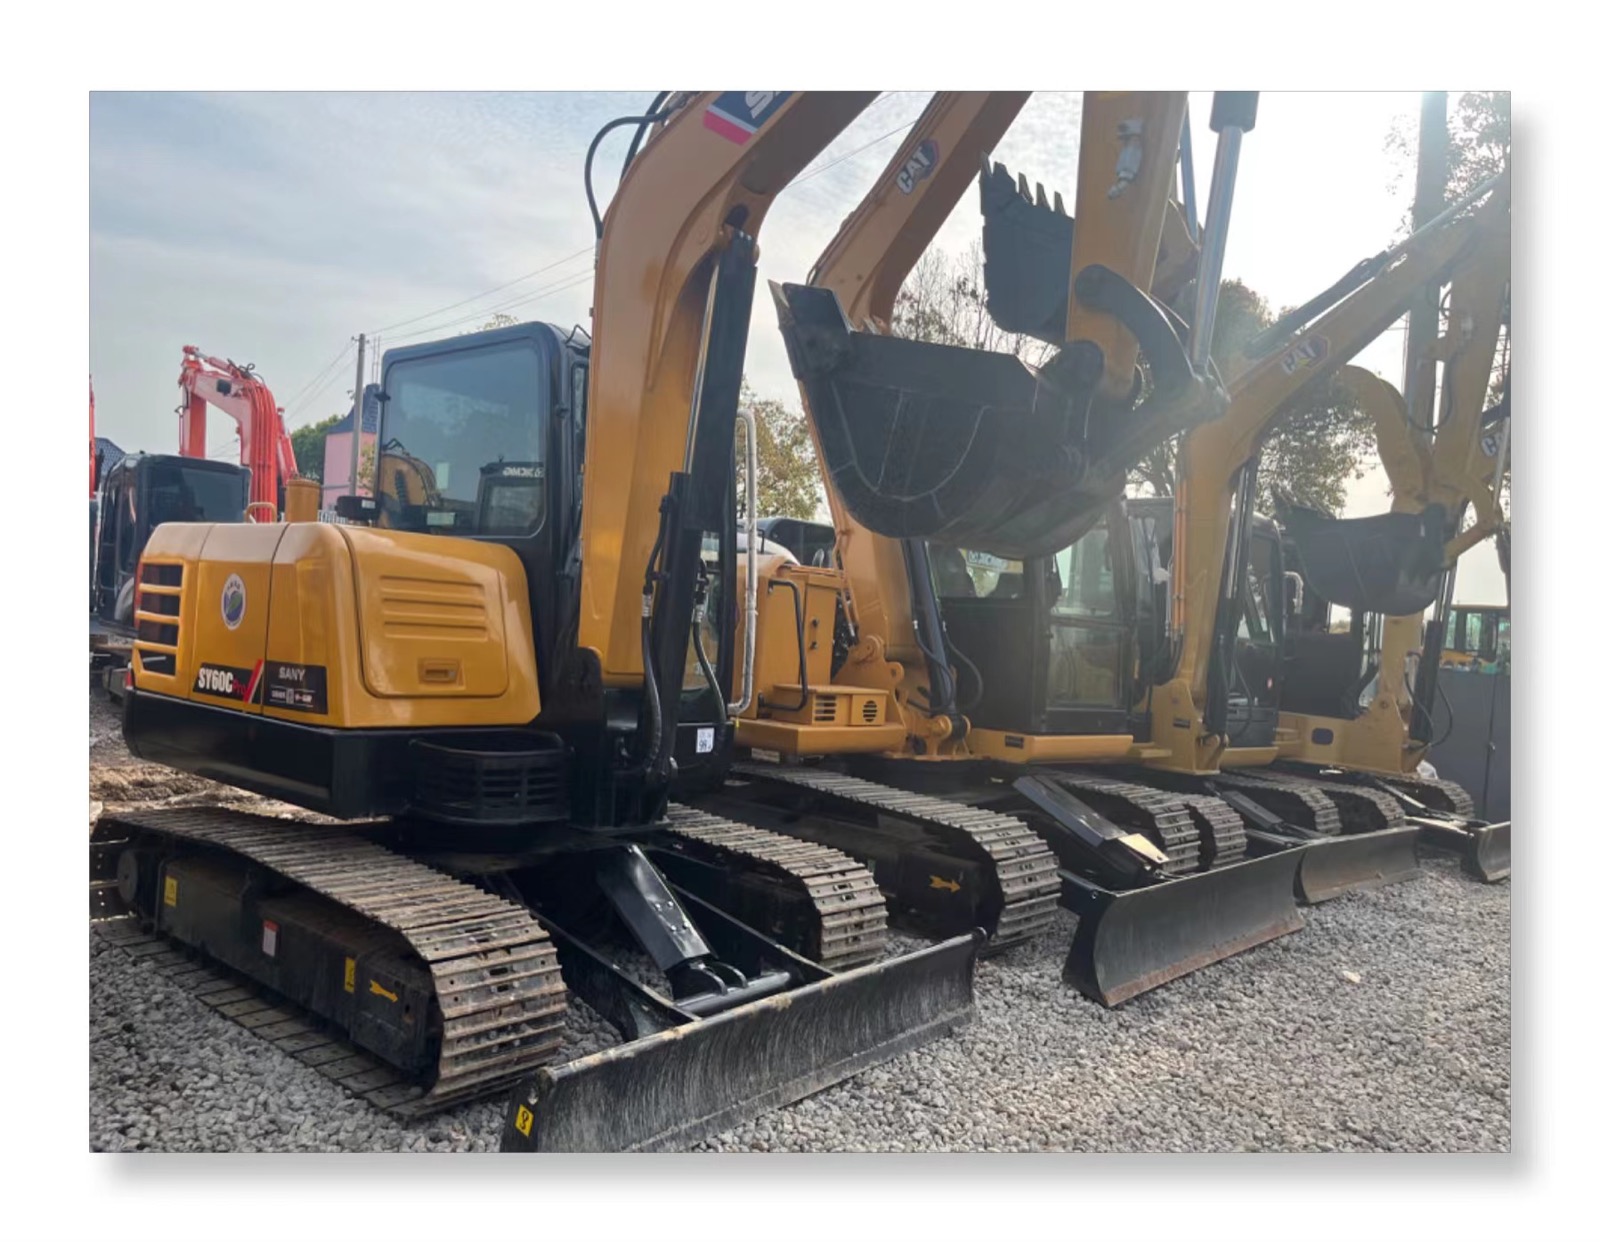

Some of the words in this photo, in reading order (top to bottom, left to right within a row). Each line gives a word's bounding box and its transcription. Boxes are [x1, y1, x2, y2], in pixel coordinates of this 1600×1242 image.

[896, 145, 931, 194] CAT
[198, 667, 233, 693] SY60C
[279, 666, 306, 681] SANY
